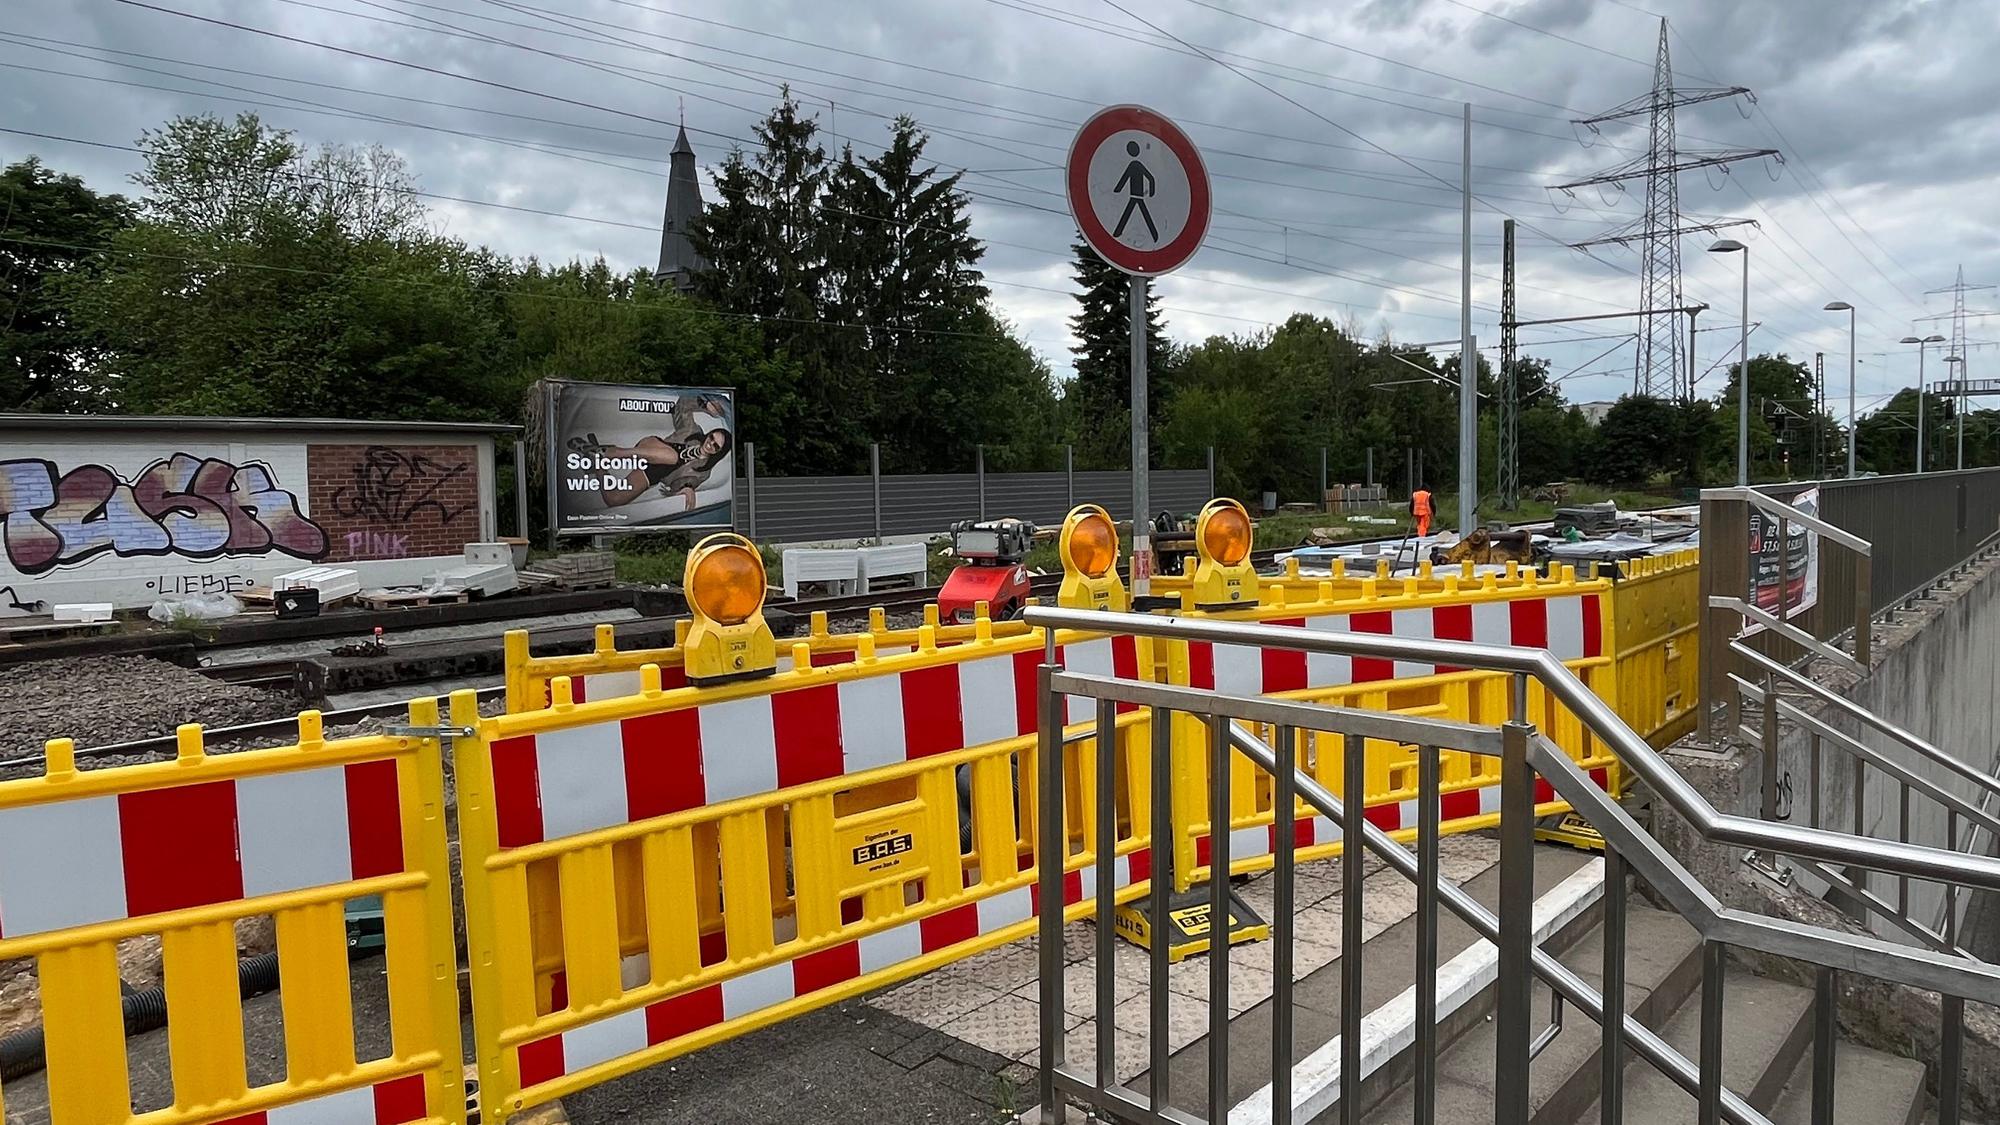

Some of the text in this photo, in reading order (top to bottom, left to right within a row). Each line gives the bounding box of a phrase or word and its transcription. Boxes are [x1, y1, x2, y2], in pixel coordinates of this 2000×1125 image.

[620, 399, 650, 412] ABOUT
[566, 453, 648, 470] So iconic
[566, 474, 633, 491] wie Du.
[344, 531, 409, 557] PINK
[857, 837, 911, 862] B.A.S.
